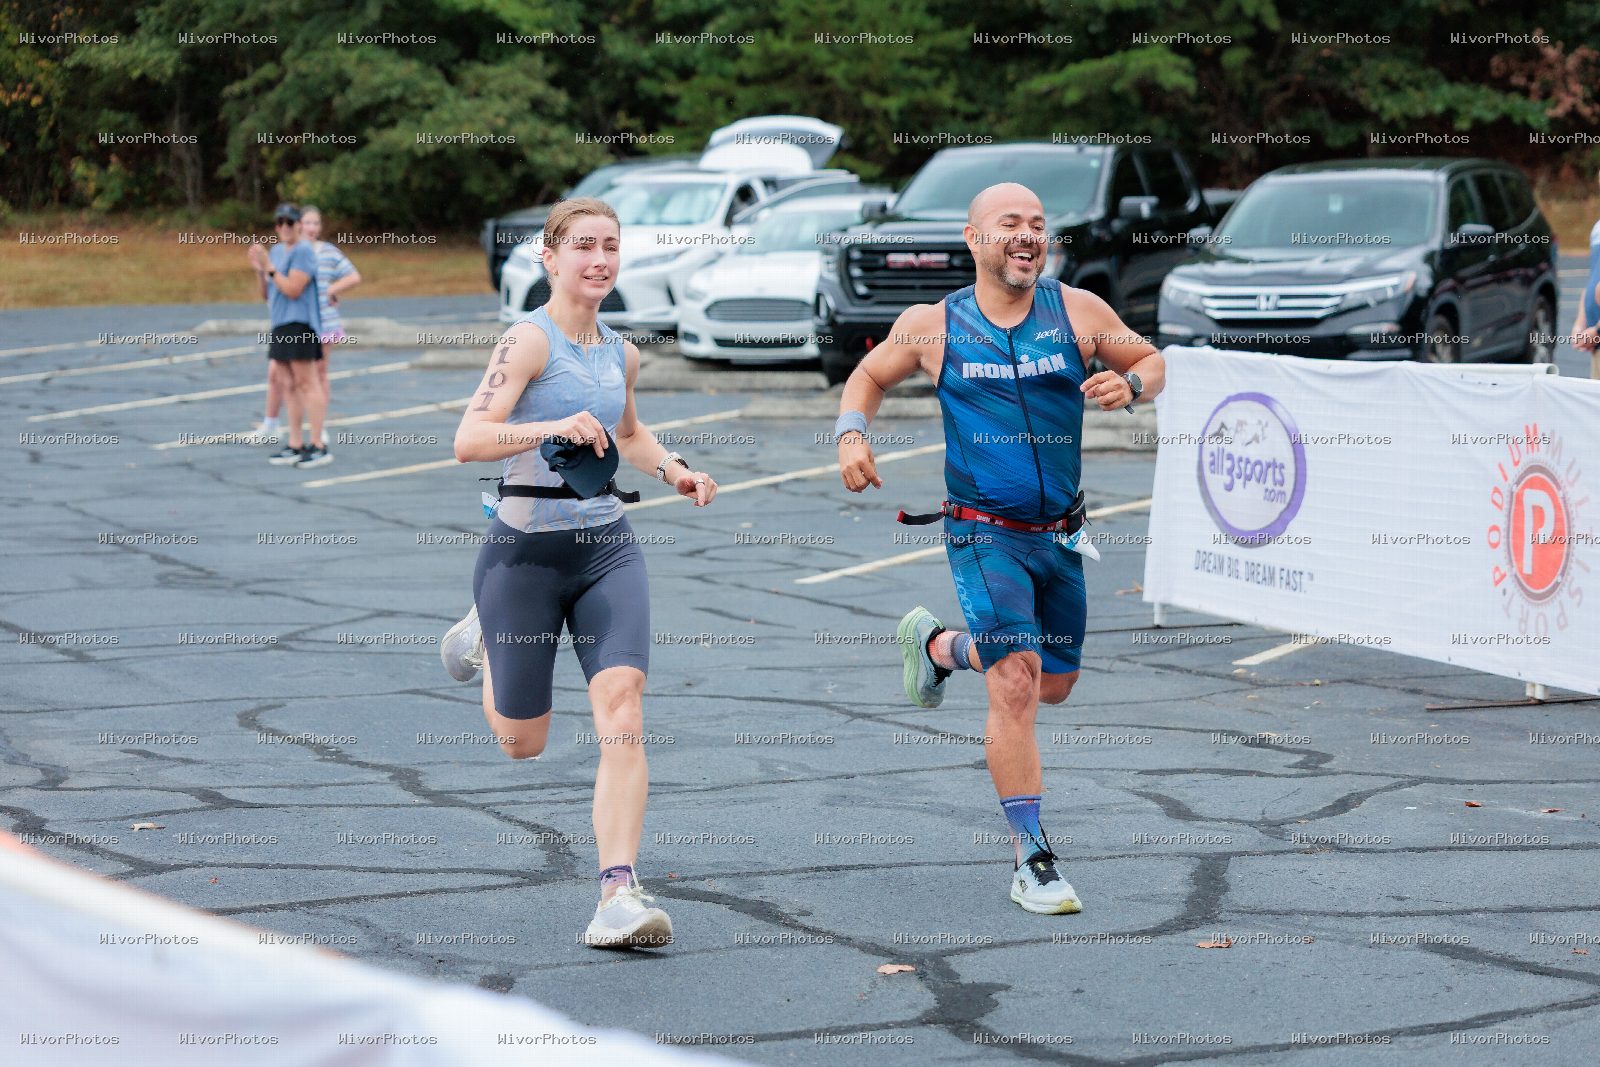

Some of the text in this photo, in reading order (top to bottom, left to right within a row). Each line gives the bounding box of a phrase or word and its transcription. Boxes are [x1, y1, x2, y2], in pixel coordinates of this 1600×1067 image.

[472, 344, 510, 412] 101
[962, 352, 1067, 380] IRONMAN
[1194, 549, 1225, 577] DREAM
[1226, 556, 1243, 580] BIG.
[1244, 560, 1276, 588] DREAM
